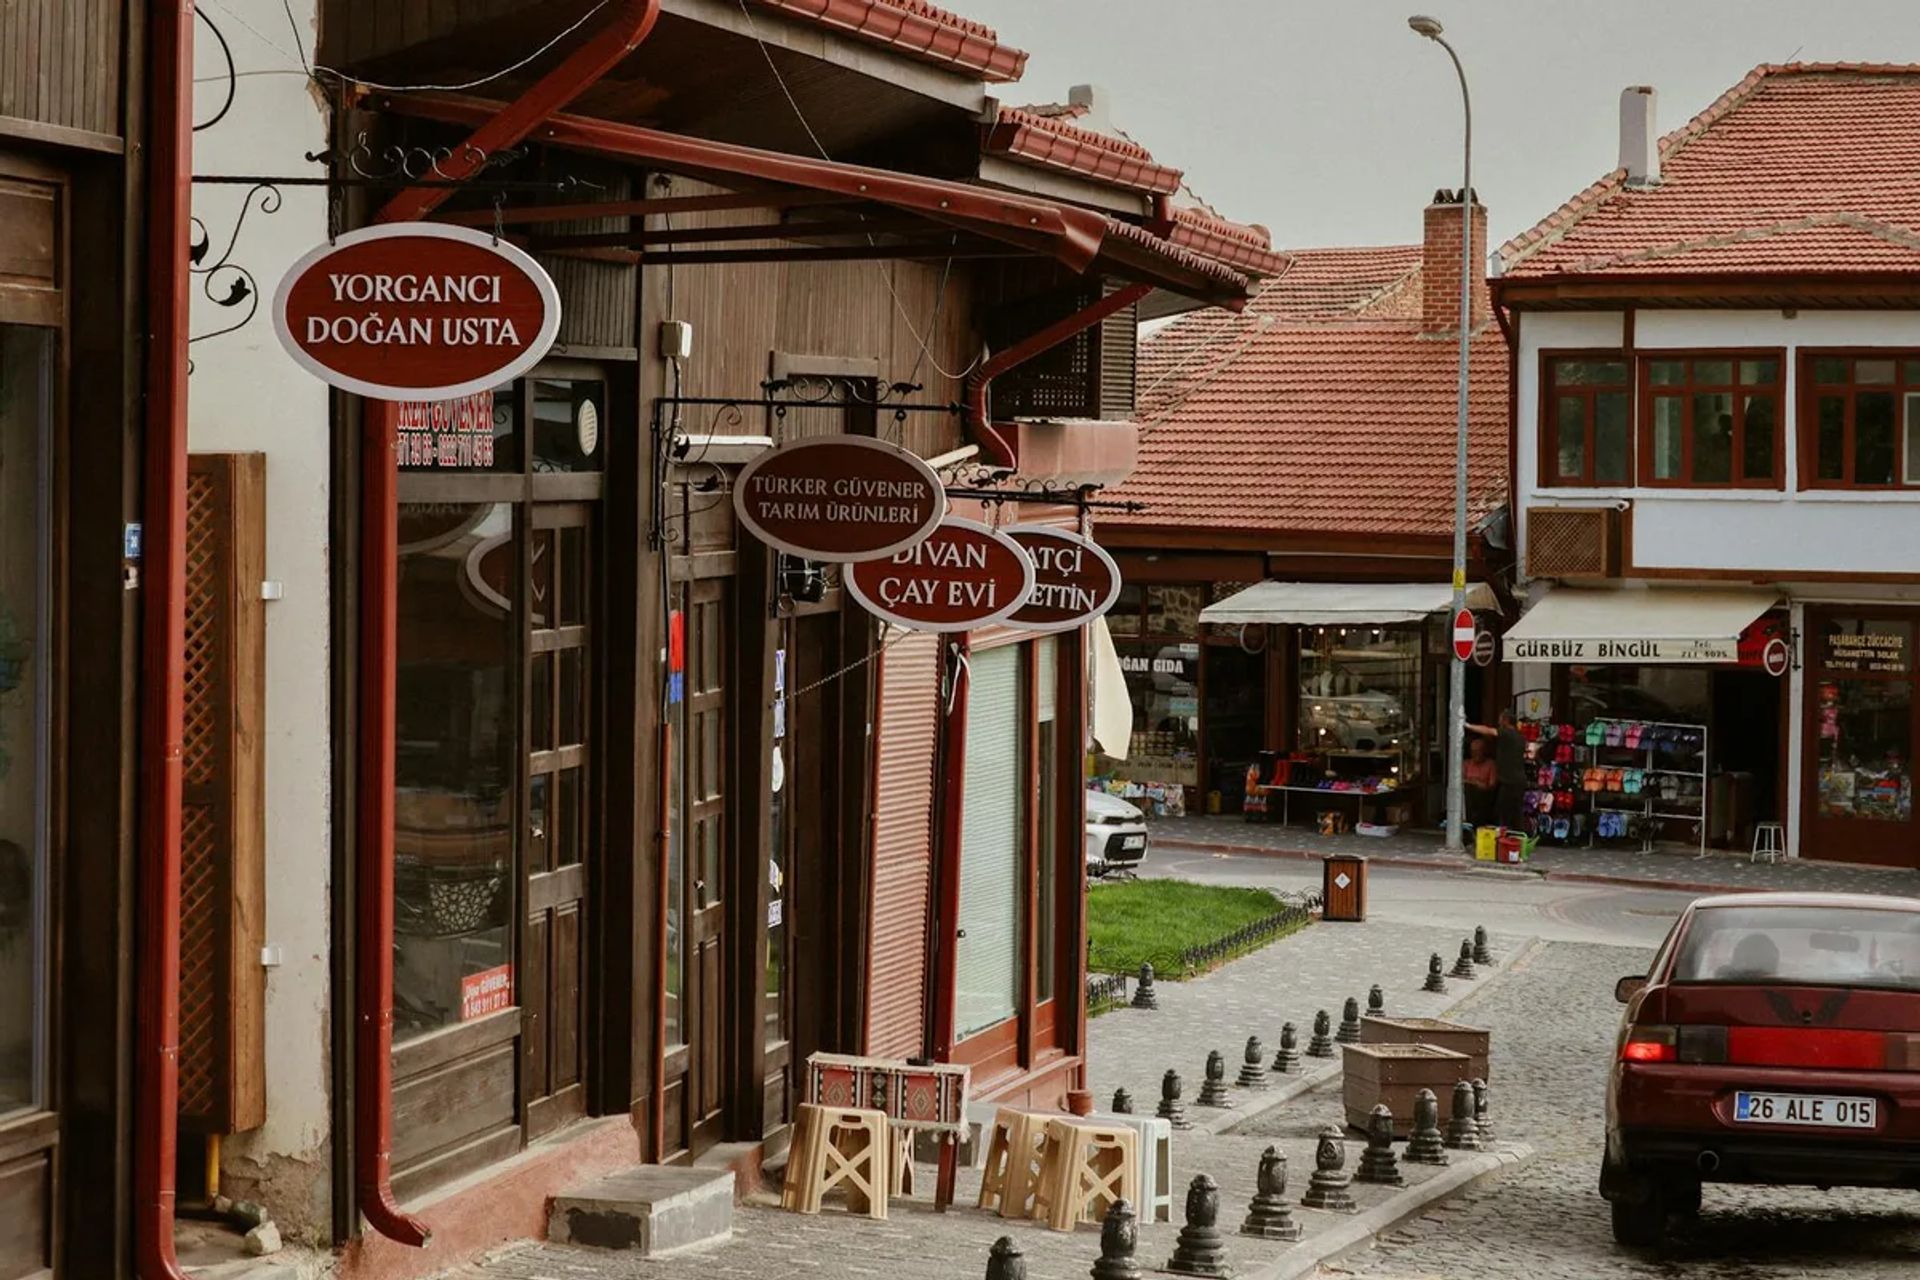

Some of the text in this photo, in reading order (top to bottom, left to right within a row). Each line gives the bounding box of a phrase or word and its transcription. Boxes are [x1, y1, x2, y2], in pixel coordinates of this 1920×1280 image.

[329, 273, 502, 303] YORGANCI
[306, 312, 522, 346] DOĞAN USTA
[752, 475, 926, 499] TÜRKER GÜVENER
[758, 501, 919, 524] TARIM ÜRÜNLERİ
[878, 577, 997, 609] ÇAY EVİ
[1025, 582, 1096, 612] ETTİN
[1515, 639, 1661, 657] GÜRBÜZ BİNGÜL
[1153, 658, 1184, 674] GIDA
[1750, 1097, 1774, 1118] 26
[1785, 1099, 1824, 1121] ALE
[1836, 1102, 1871, 1124] 015
